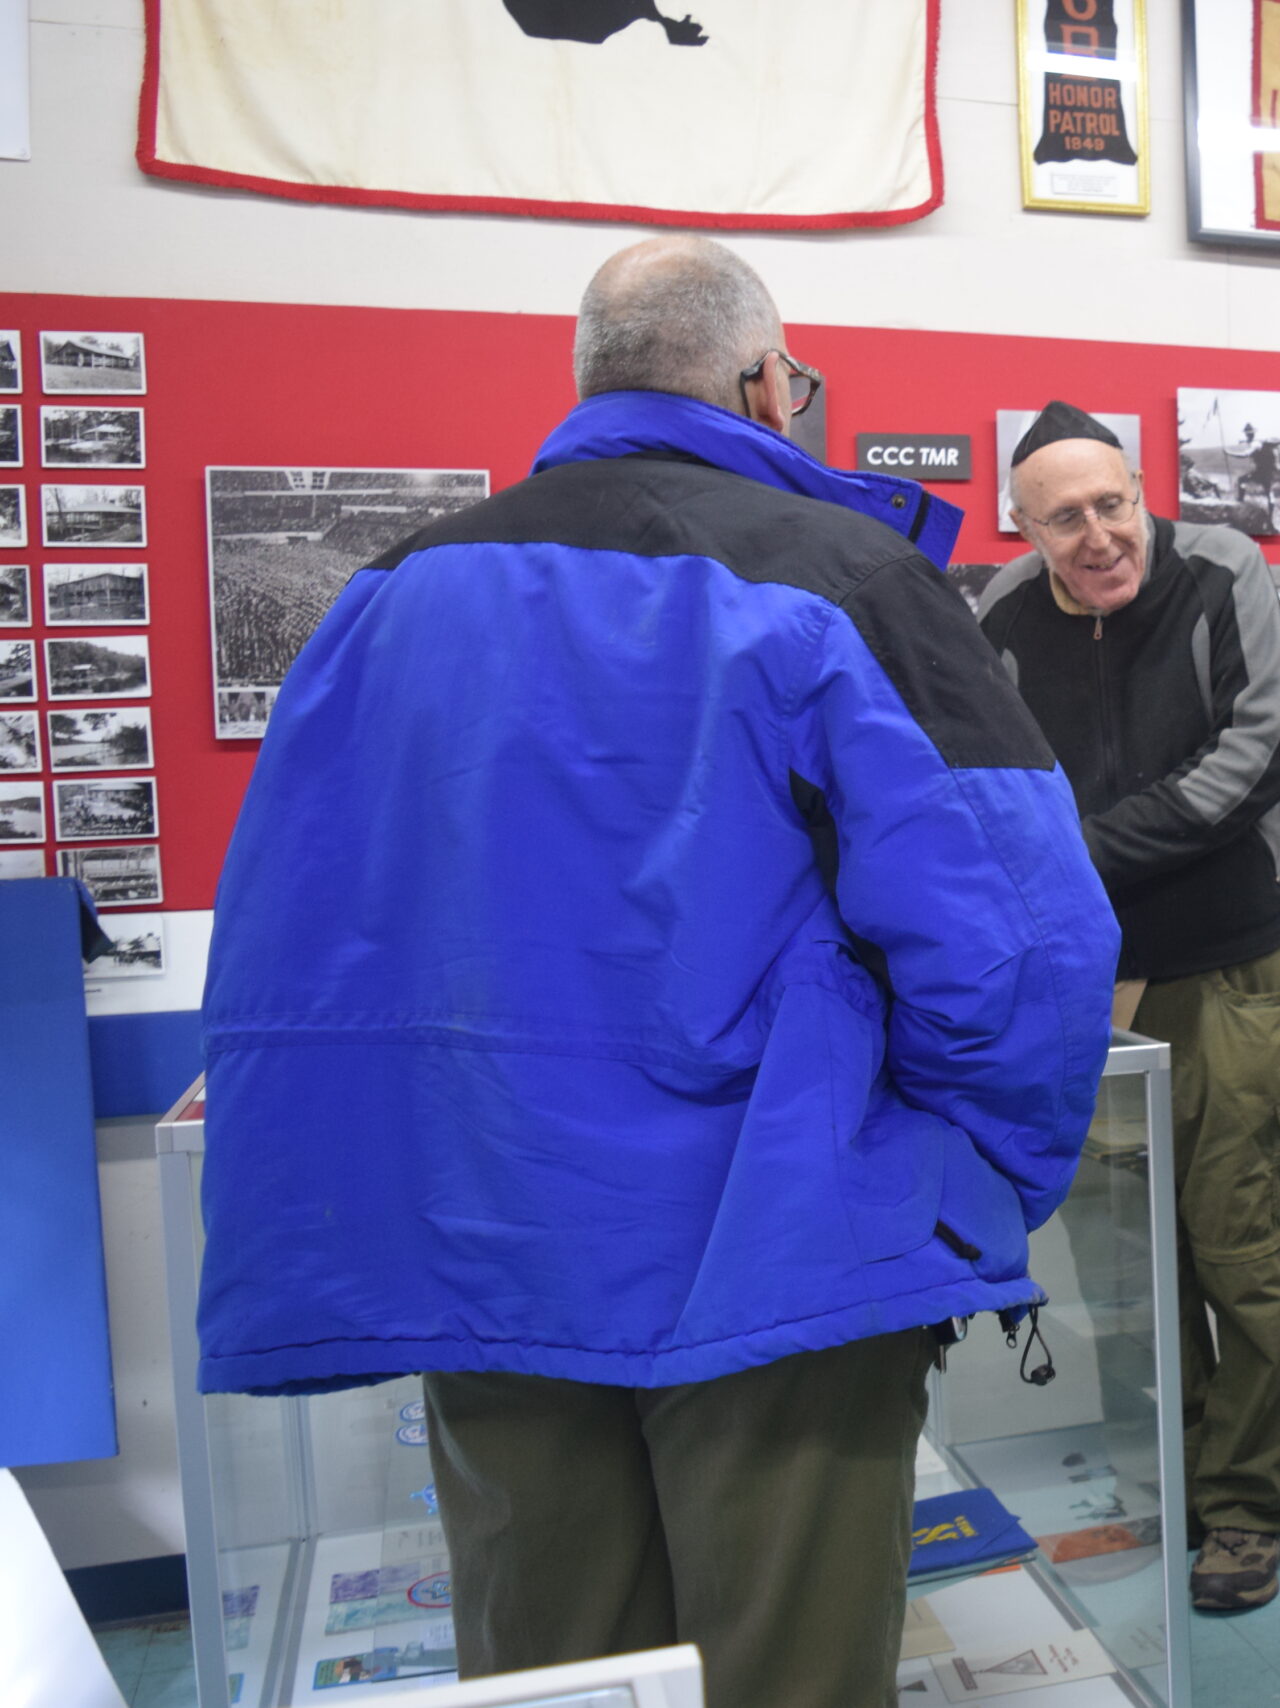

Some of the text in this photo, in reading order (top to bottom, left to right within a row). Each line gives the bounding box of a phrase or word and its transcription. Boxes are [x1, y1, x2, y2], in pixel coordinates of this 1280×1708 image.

[1048, 82, 1117, 109] HONOR
[1049, 109, 1120, 136] PATROL
[867, 446, 960, 466] CCC TMR
